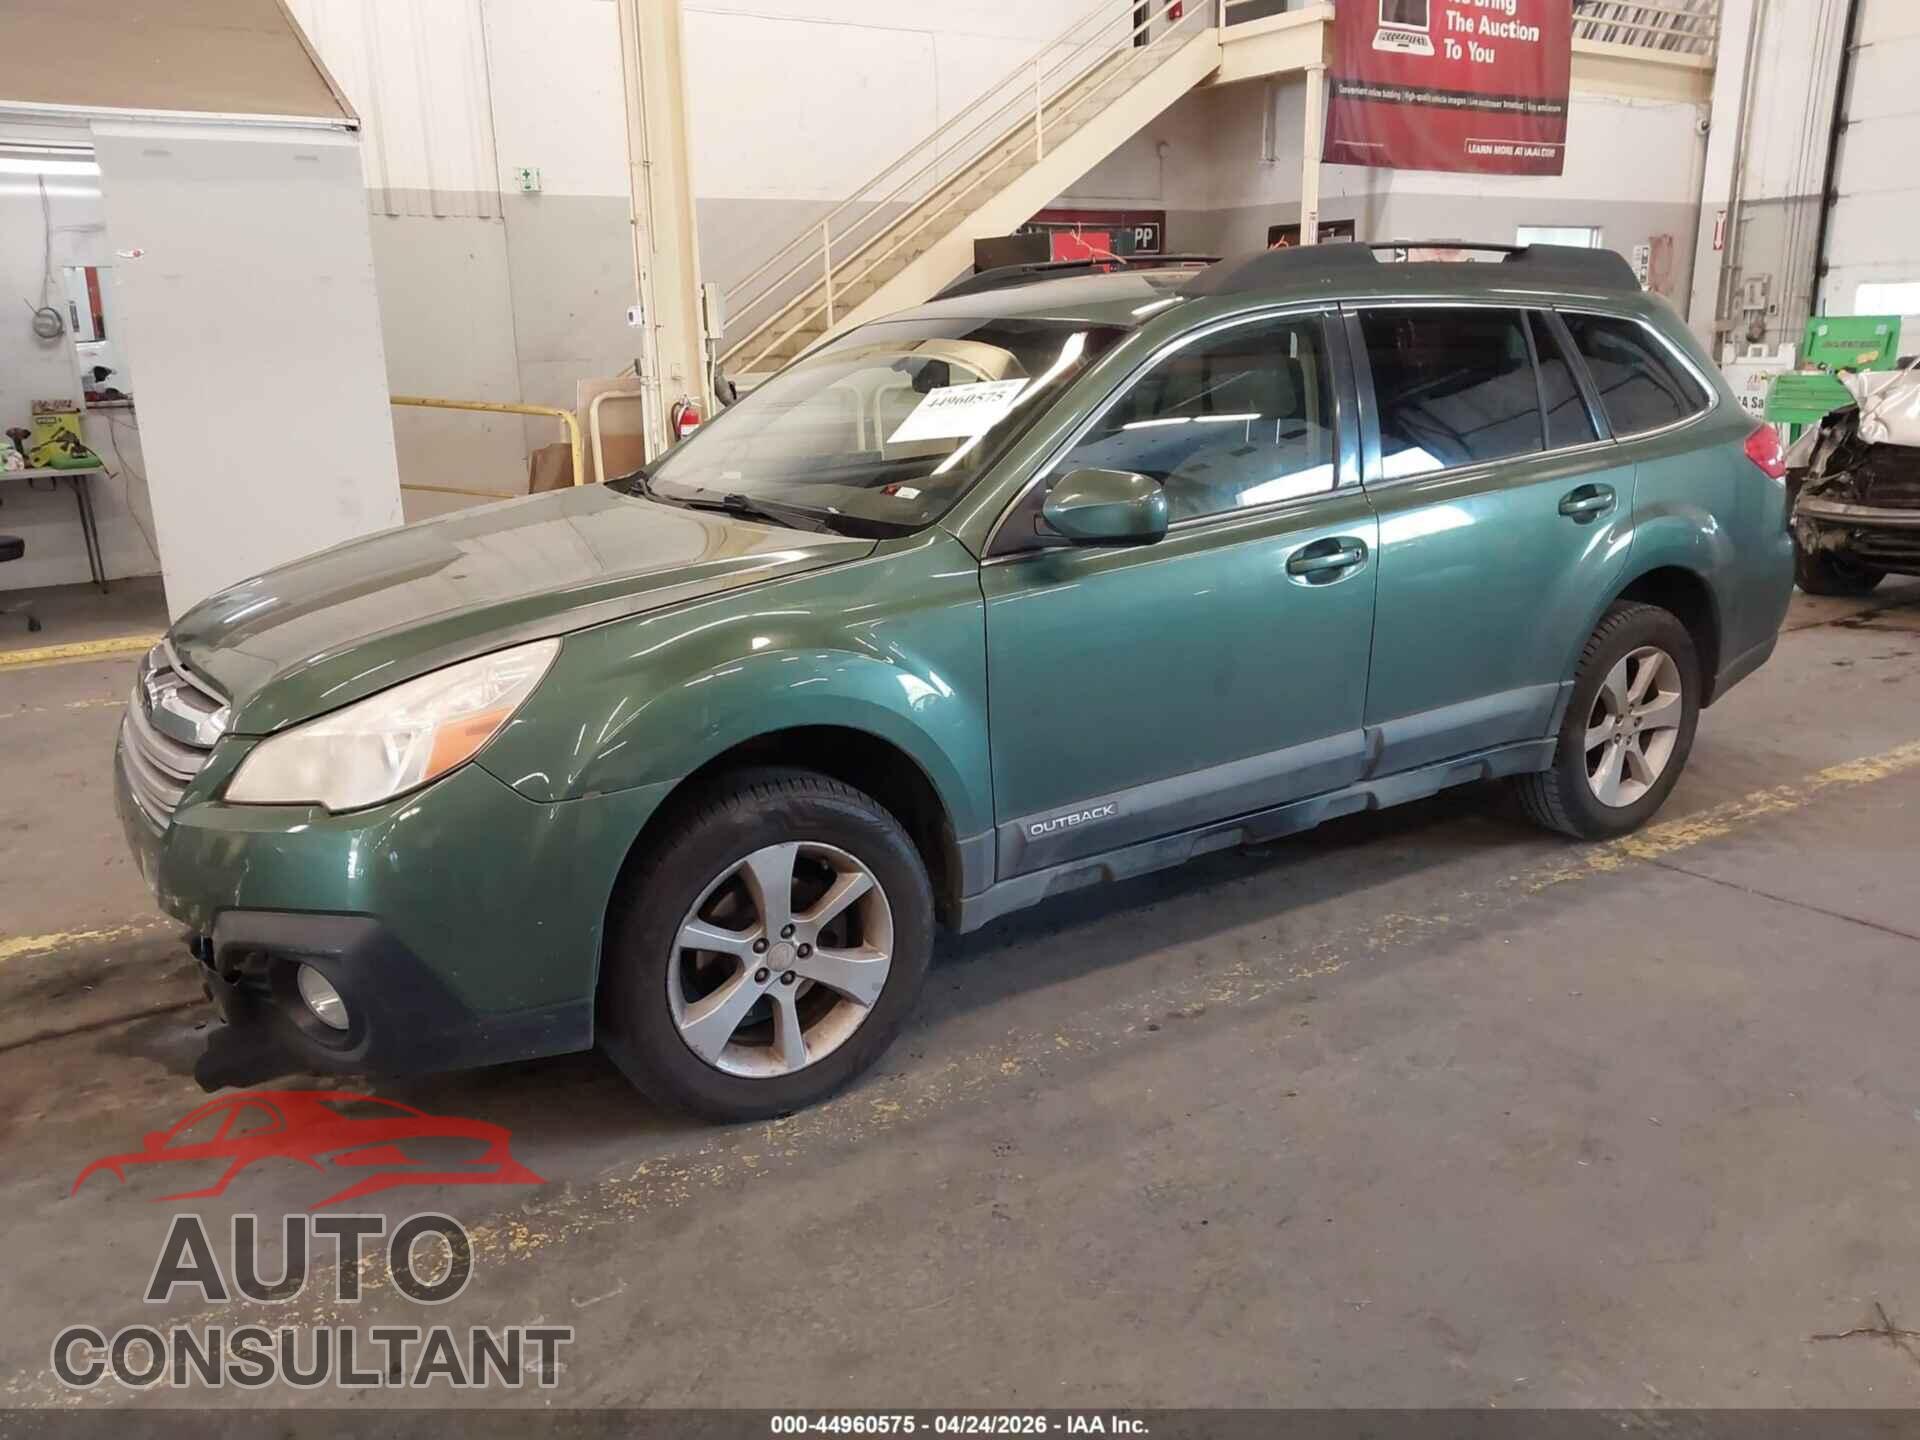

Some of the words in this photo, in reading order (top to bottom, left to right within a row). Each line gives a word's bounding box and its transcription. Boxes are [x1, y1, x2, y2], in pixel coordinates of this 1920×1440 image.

[1446, 9, 1474, 32] The
[1479, 15, 1540, 41] Auction
[1444, 39, 1462, 60] To
[1468, 41, 1495, 63] You
[1468, 143, 1492, 154] LEARN
[1493, 145, 1513, 156] MORE
[1030, 804, 1115, 836] OUTBACK
